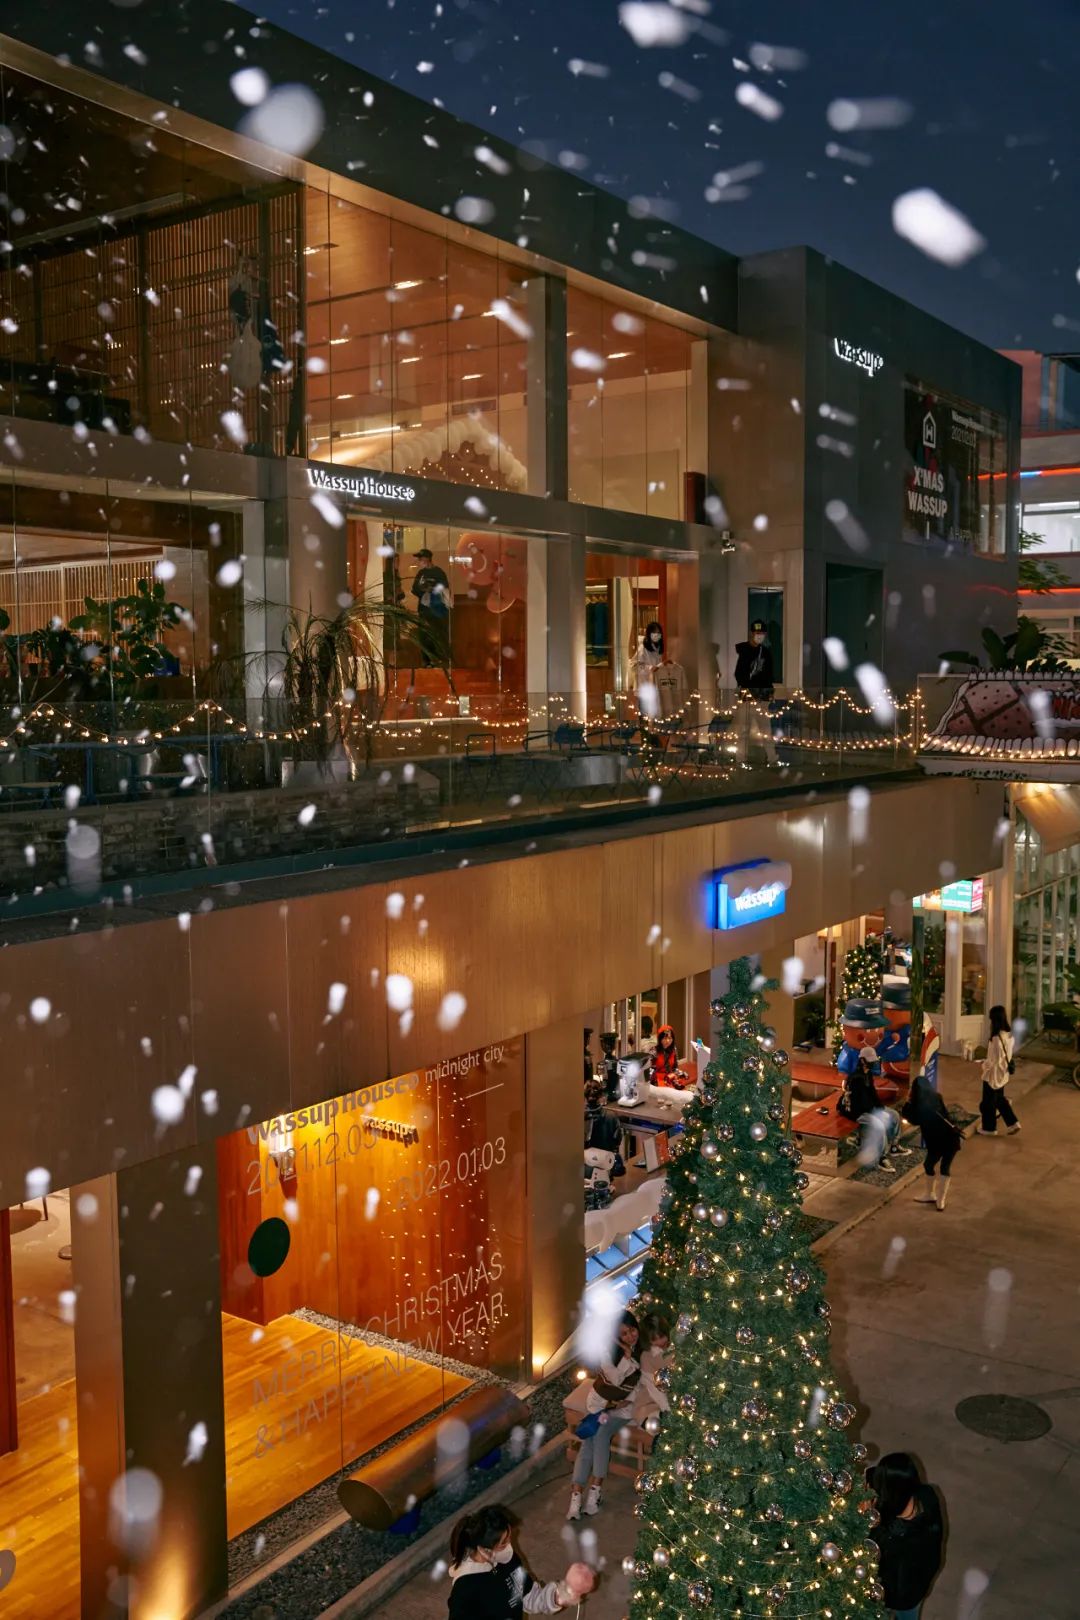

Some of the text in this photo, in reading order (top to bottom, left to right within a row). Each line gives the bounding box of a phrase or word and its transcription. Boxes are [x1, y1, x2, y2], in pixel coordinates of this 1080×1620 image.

[913, 465, 944, 493] X'MAS
[907, 490, 948, 519] WASSUP
[425, 1052, 481, 1085] midnight
[483, 1044, 505, 1063] city
[253, 1252, 503, 1409] MERRY CHRISTMAS
[255, 1292, 503, 1460] & HAPPY NEW YEAR
